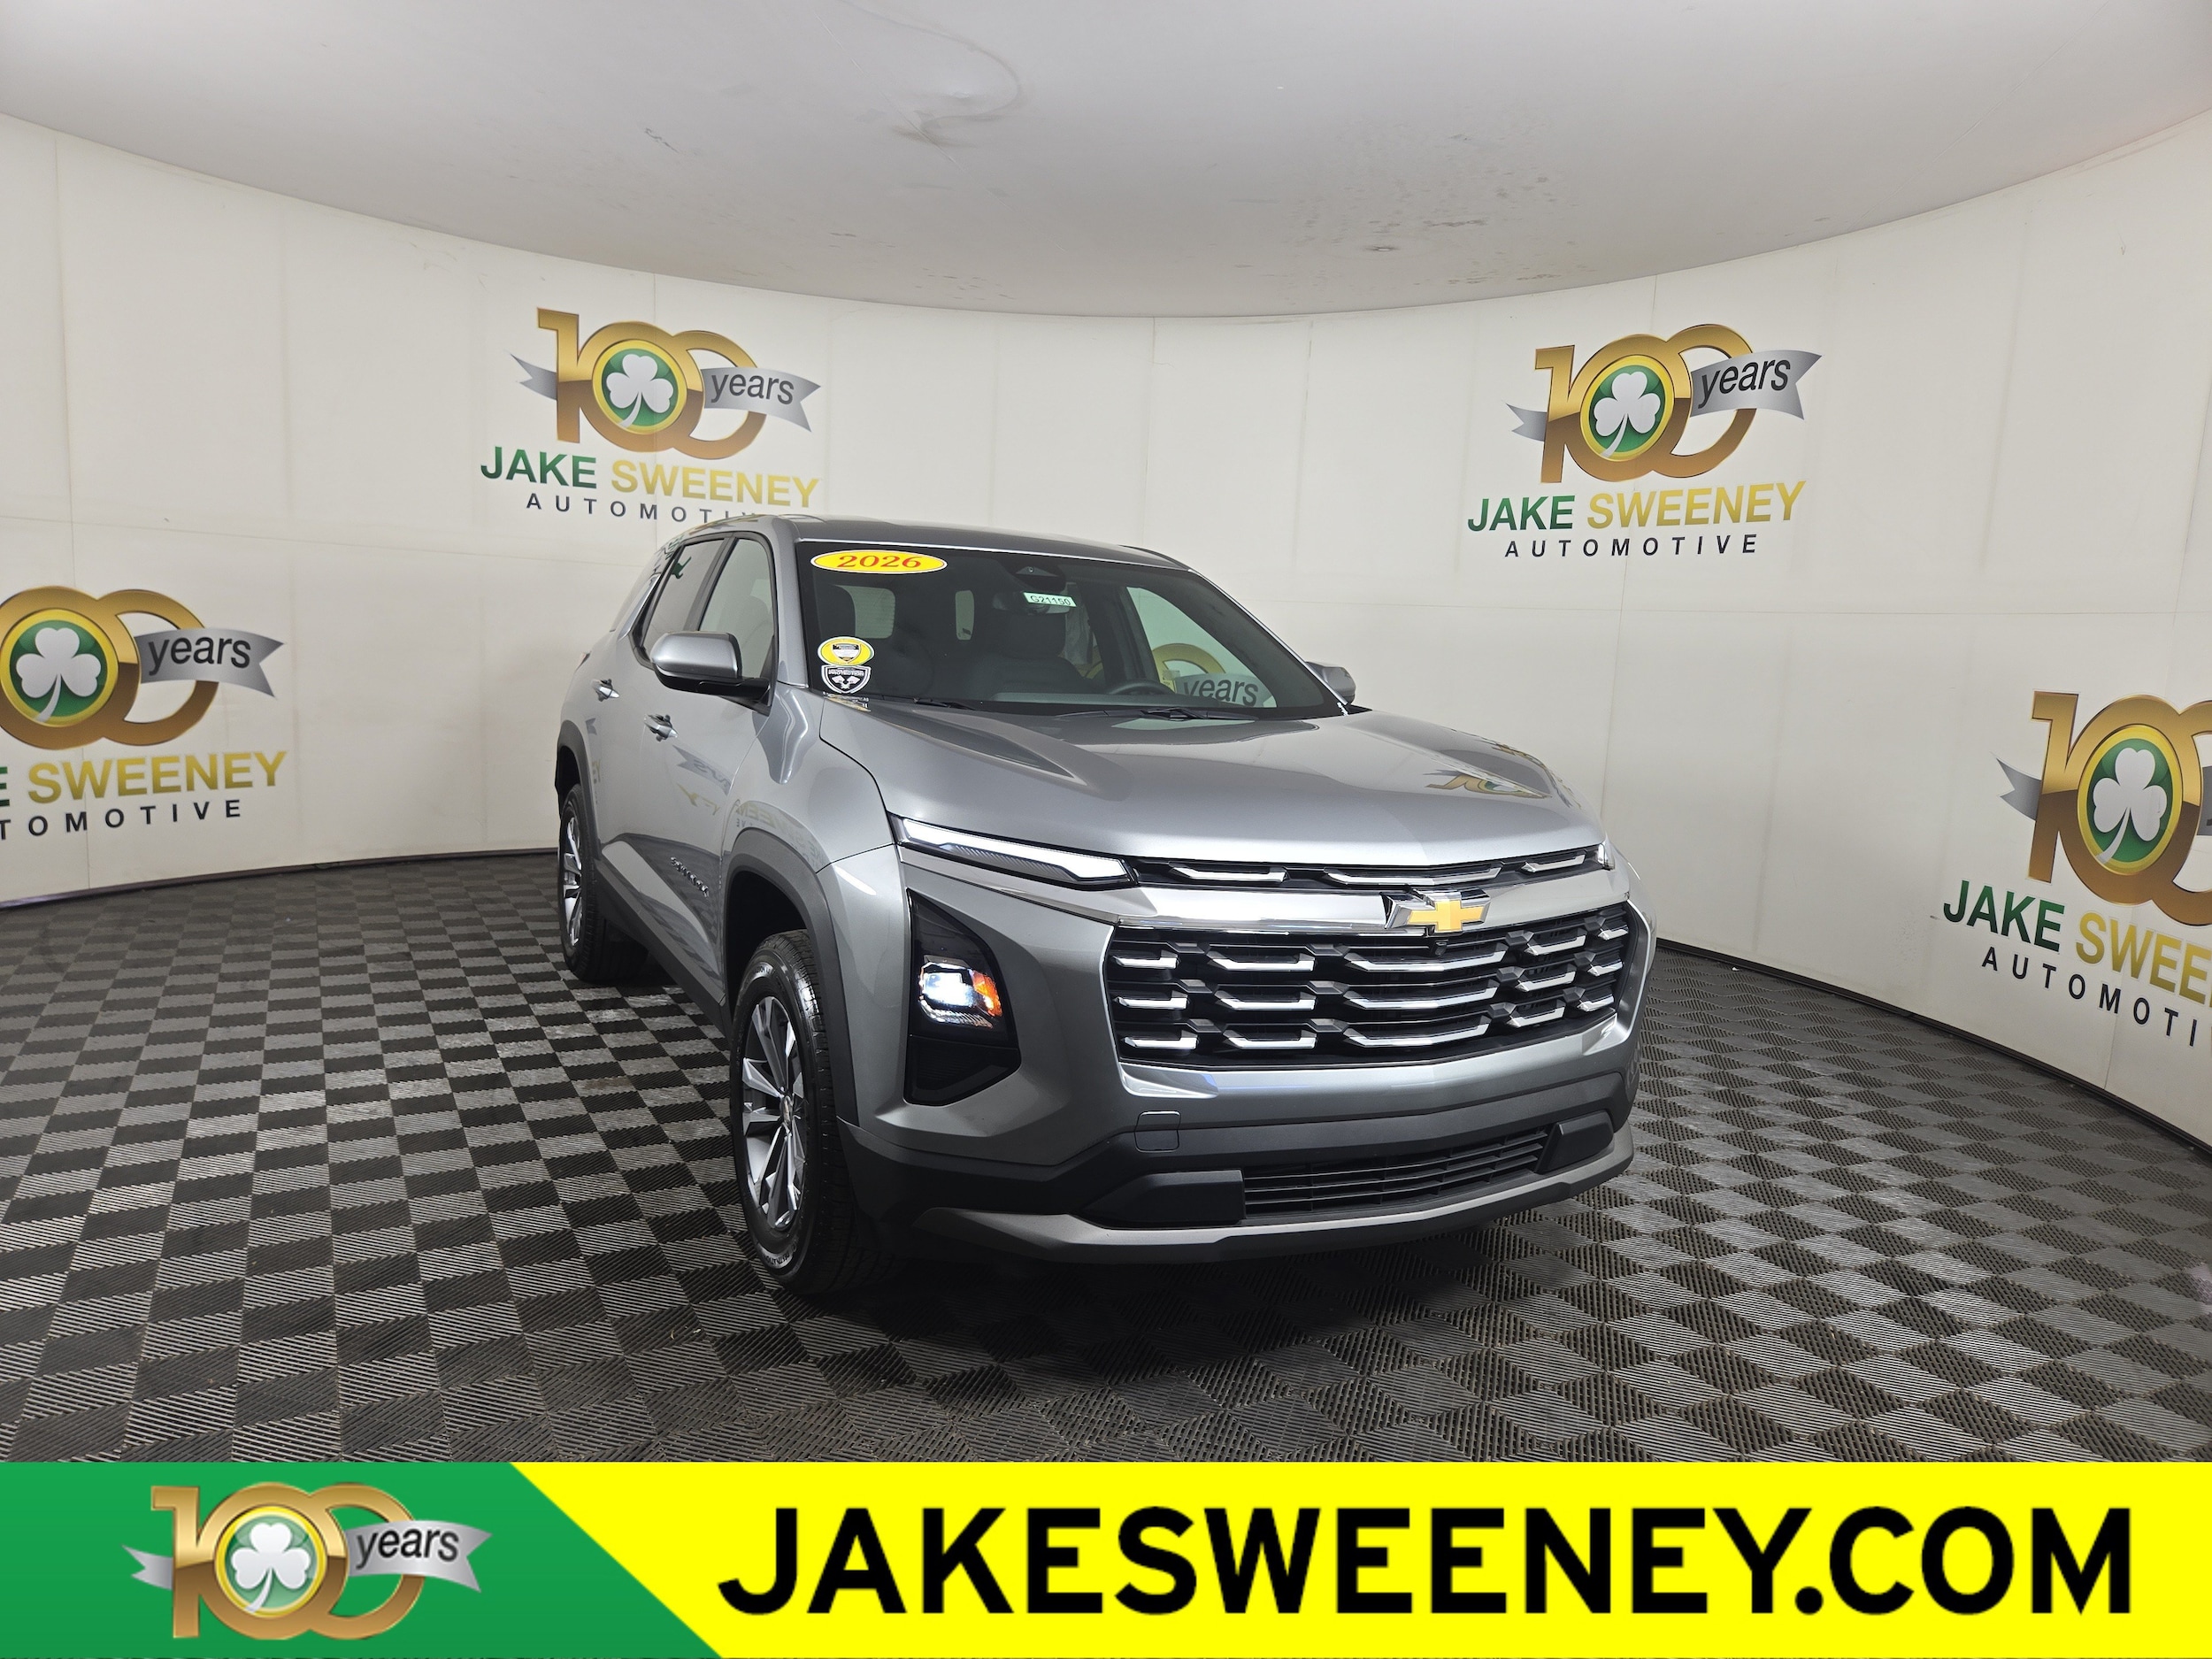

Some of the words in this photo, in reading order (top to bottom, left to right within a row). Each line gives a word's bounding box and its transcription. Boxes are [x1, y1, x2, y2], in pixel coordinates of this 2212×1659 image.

[710, 372, 795, 405] years
[1698, 358, 1791, 409] years
[480, 445, 597, 489] JAKE
[611, 458, 819, 508] SWEENEY
[526, 493, 756, 524] AUTOMOTI
[1467, 495, 1575, 532] JAKE
[1587, 480, 1806, 529] SWEENEY
[837, 555, 922, 568] 2026
[1505, 534, 1757, 557] AUTOMOTIVE
[1030, 595, 1071, 605] G21150
[0, 585, 219, 750] 00
[148, 635, 251, 676] years
[27, 750, 287, 804] SWEENEY
[0, 799, 241, 841] TOMOTIVE
[1943, 879, 2065, 953] JAKE
[2075, 912, 2212, 1006] SWEE
[1981, 946, 2198, 1047] AUTOMOTI
